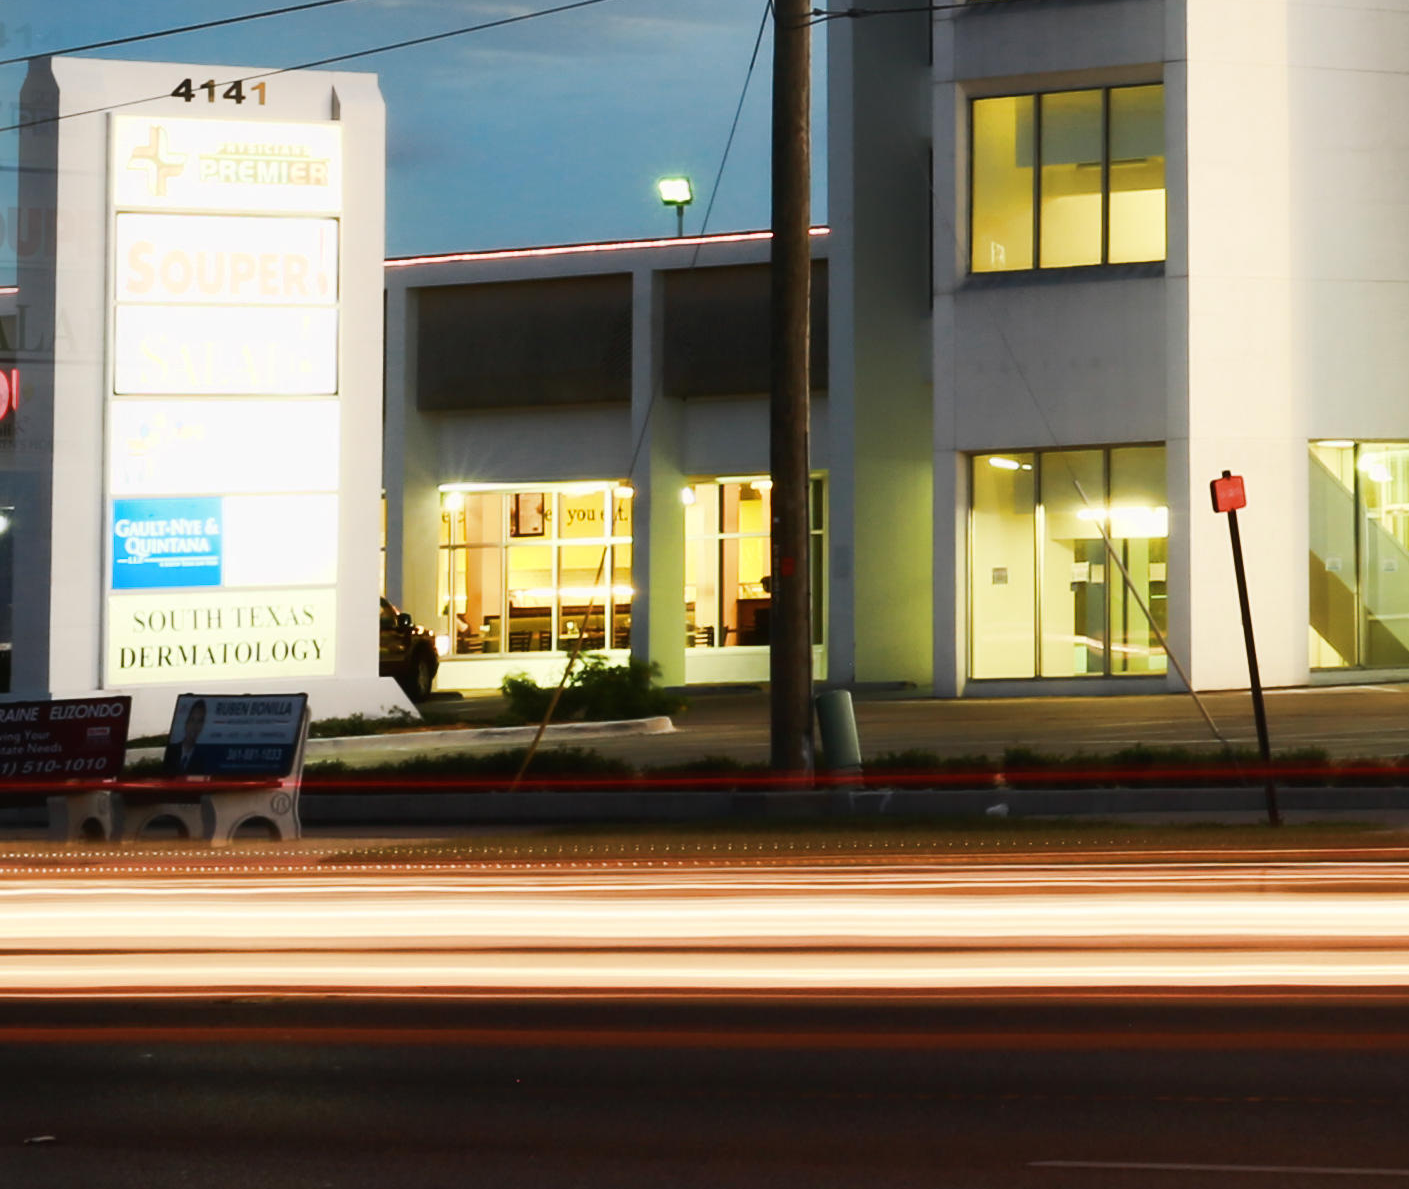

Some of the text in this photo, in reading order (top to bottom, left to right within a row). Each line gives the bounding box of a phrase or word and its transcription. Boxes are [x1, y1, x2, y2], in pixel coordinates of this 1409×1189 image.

[170, 78, 267, 106] 4141
[199, 158, 329, 186] PREMIER
[204, 517, 220, 535] &
[568, 507, 595, 526] you
[124, 536, 210, 557] QUINTANA
[133, 604, 316, 633] SOUTH TEXAS
[118, 637, 327, 670] DERMATOLOGY
[49, 702, 124, 721] ELIZONDO
[216, 701, 248, 716] RUBEN
[24, 729, 51, 741] Your
[26, 742, 62, 754] Needs
[22, 755, 107, 774] 510-1010
